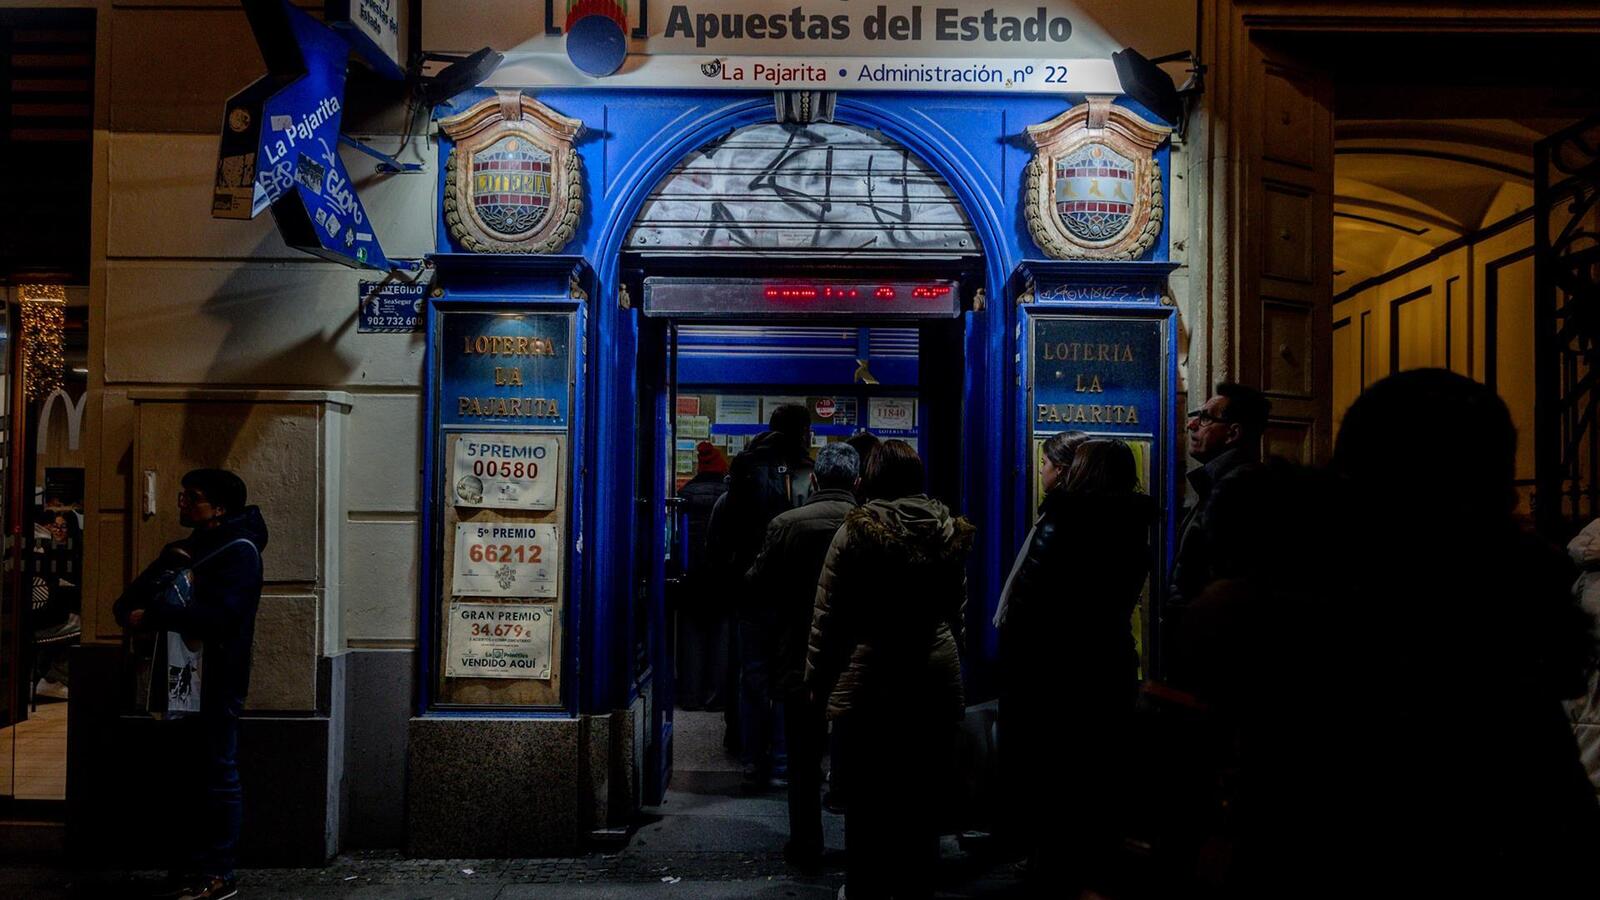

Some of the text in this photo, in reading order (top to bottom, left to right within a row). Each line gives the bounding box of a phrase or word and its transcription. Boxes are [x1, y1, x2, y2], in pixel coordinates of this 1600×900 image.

[360, 4, 381, 34] Estado
[664, 5, 1072, 47] Apuestas del Estado
[722, 63, 1068, 85] La Pajarita Administración nº 22
[264, 95, 341, 165] La Pajarita
[368, 285, 423, 294] POTEGIDO
[367, 316, 385, 325] 902
[386, 316, 404, 325] 732
[464, 335, 555, 356] LOTERIA
[1043, 343, 1134, 362] LOTERIA
[495, 367, 523, 386] LA
[1076, 374, 1103, 393] LA
[458, 397, 560, 418] PAJARITA
[1037, 404, 1140, 424] PAJARITA
[480, 444, 546, 459] PREMIO
[473, 460, 538, 478] 00580
[493, 528, 536, 538] PREMIO
[469, 544, 542, 563] 66212
[461, 611, 541, 621] GRAN PREMIO
[461, 658, 536, 668] VENDIDO AQUÍ
